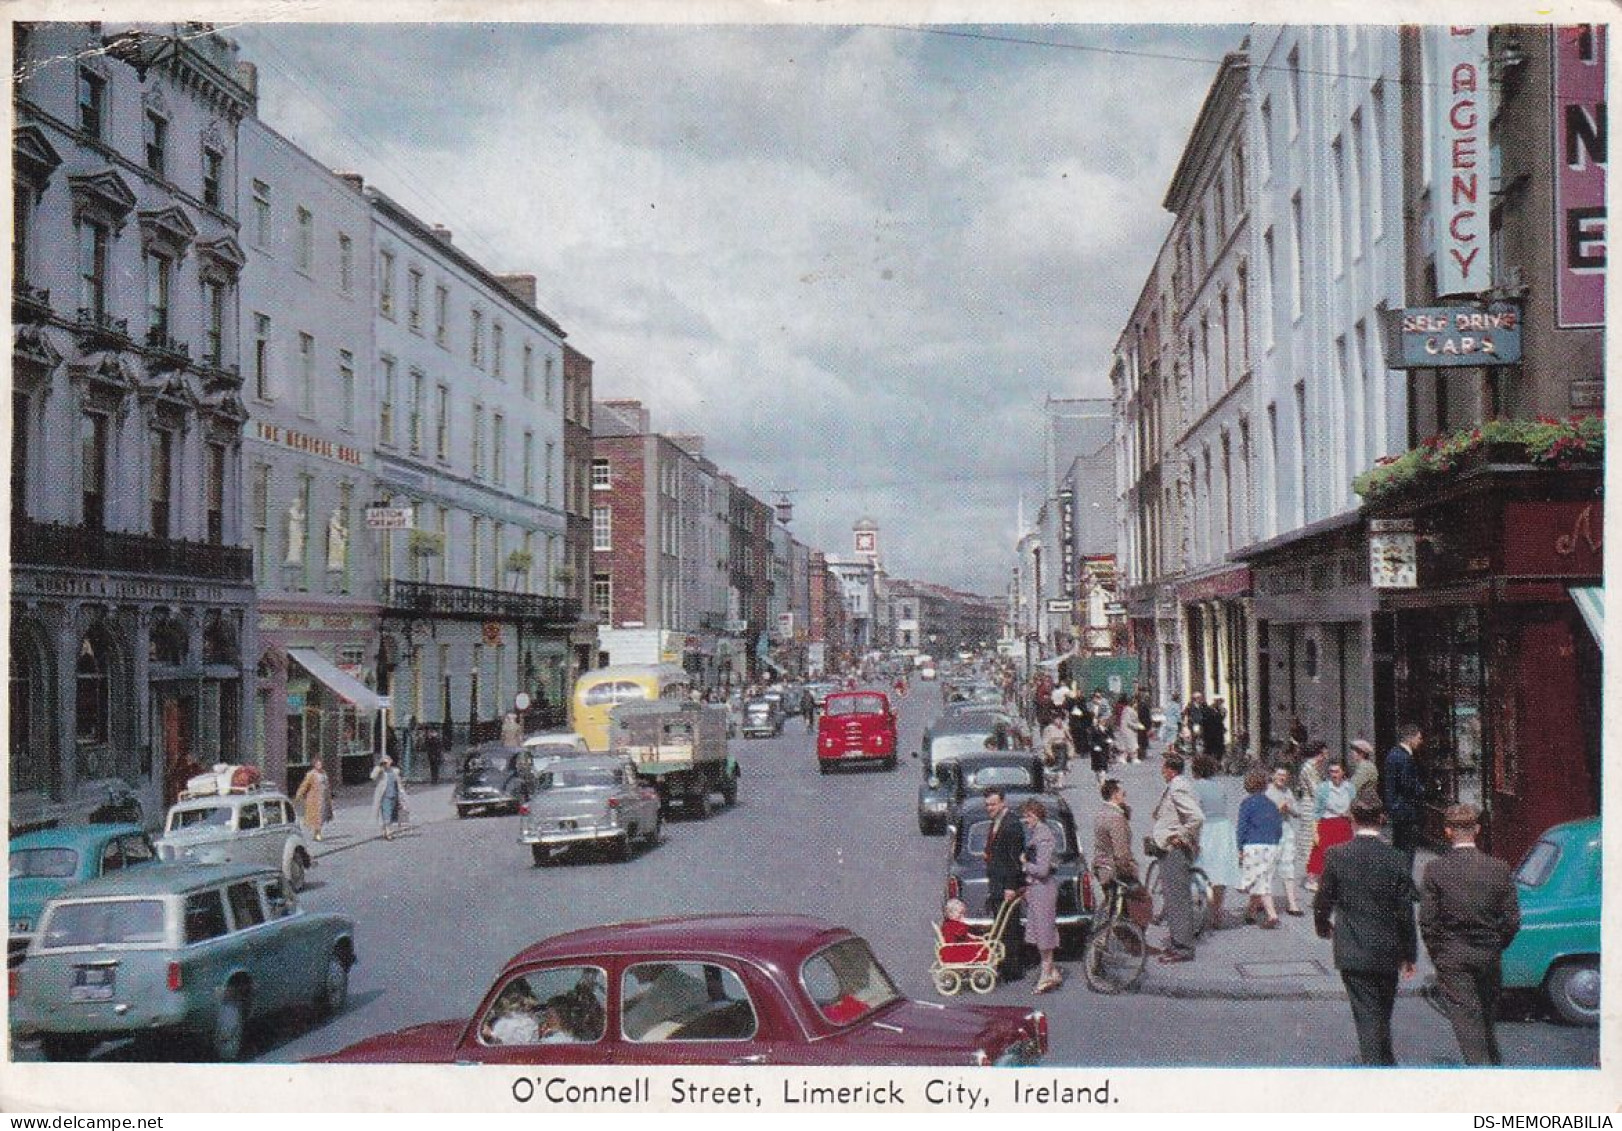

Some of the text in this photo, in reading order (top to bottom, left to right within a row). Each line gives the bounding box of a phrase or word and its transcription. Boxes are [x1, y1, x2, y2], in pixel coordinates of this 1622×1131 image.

[1449, 63, 1479, 279] AGENCY
[1402, 312, 1516, 333] SELF DRIVE
[1425, 335, 1496, 355] CARS
[257, 421, 361, 465] THE MEDICAL HALL
